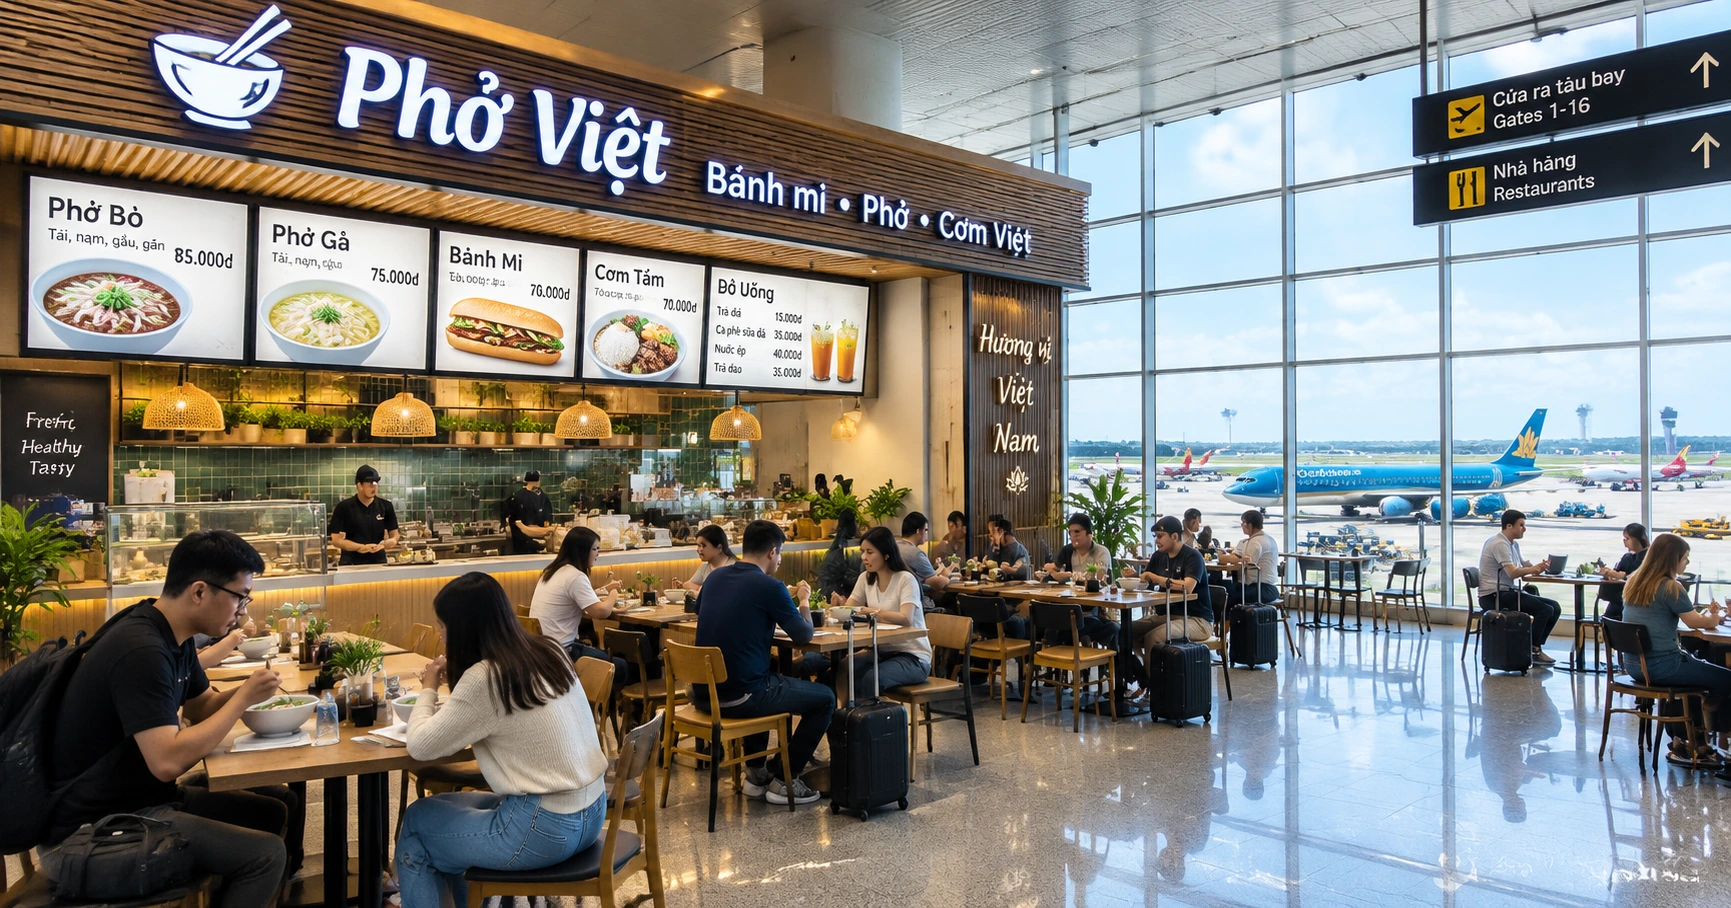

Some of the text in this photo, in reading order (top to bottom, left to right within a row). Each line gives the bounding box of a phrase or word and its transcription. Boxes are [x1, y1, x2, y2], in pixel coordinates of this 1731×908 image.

[1533, 85, 1551, 100] ra
[1591, 68, 1626, 88] bay
[337, 46, 671, 197] Phở Việt
[1493, 97, 1591, 129] Gates 1-16
[1494, 175, 1595, 202] Restaurants
[48, 196, 102, 224] Phở
[862, 193, 911, 230] Phở
[939, 211, 987, 245] Cơm
[272, 223, 315, 247] Phở
[595, 264, 629, 284] Cơm
[994, 422, 1040, 454] Nam
